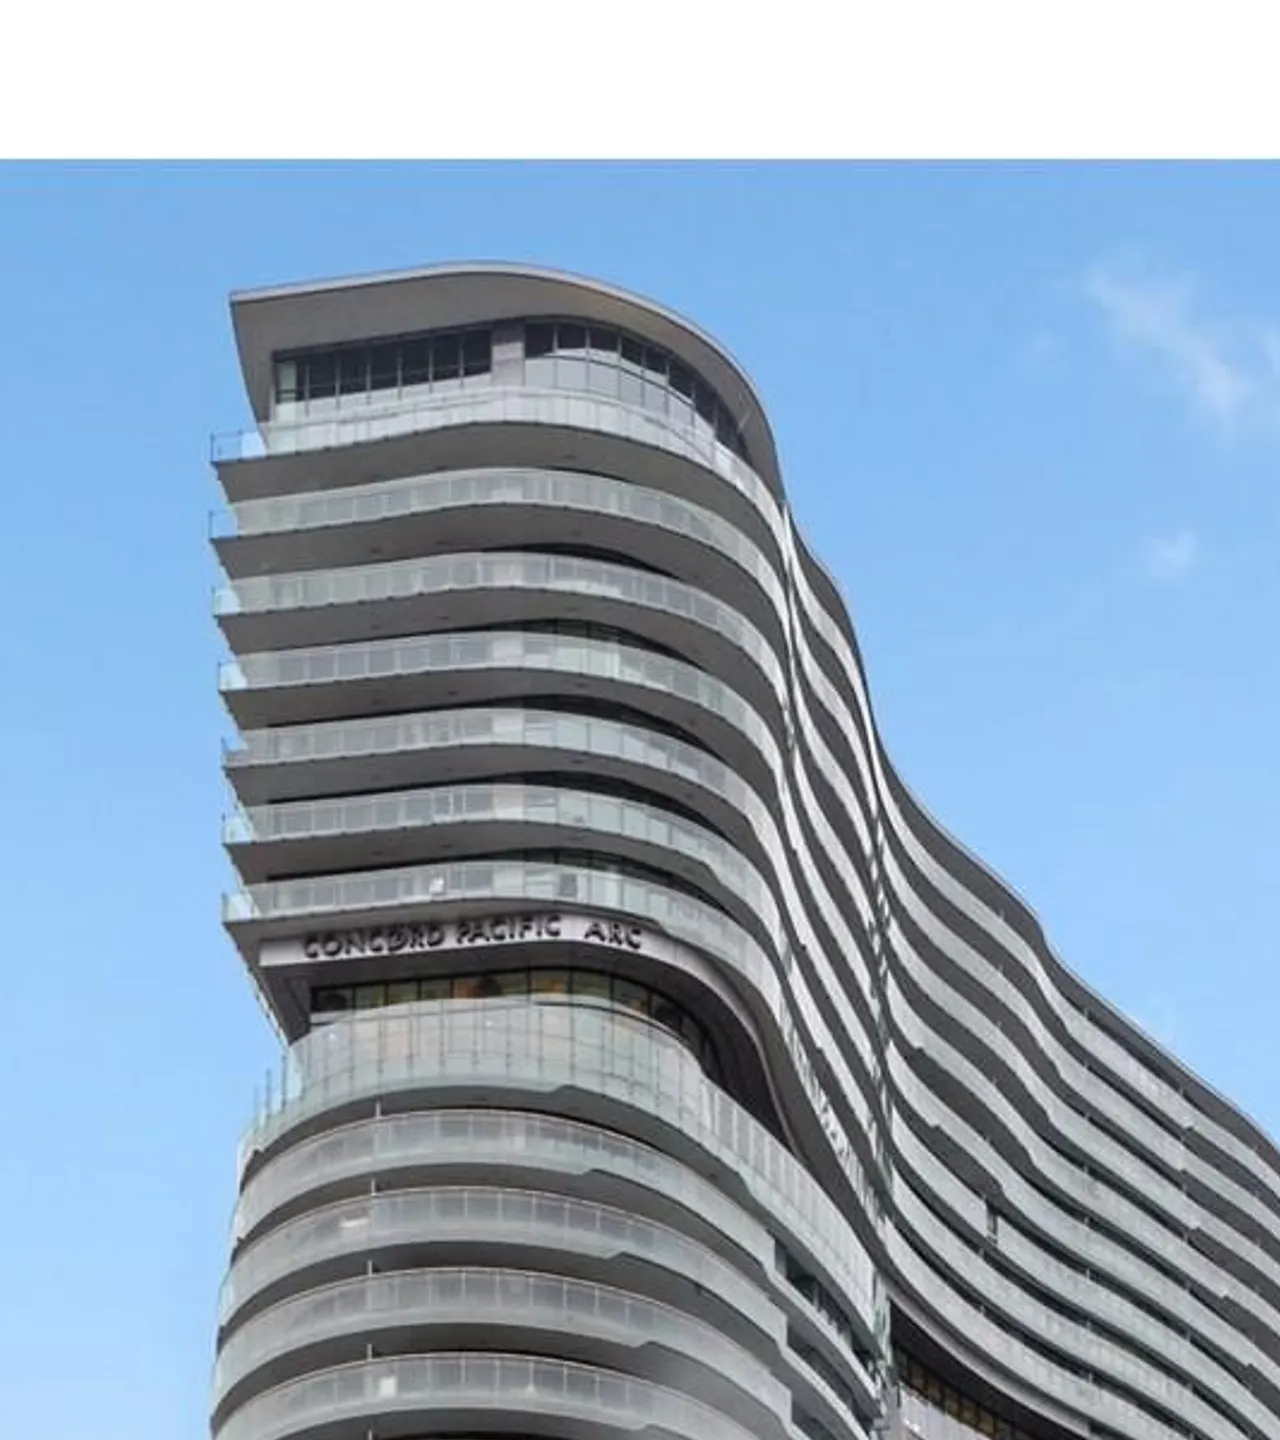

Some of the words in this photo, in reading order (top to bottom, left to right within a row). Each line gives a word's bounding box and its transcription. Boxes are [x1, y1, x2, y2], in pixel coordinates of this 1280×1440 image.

[303, 922, 446, 958] CONCORD
[456, 914, 562, 945] PACIFIC
[583, 921, 642, 950] ARC
